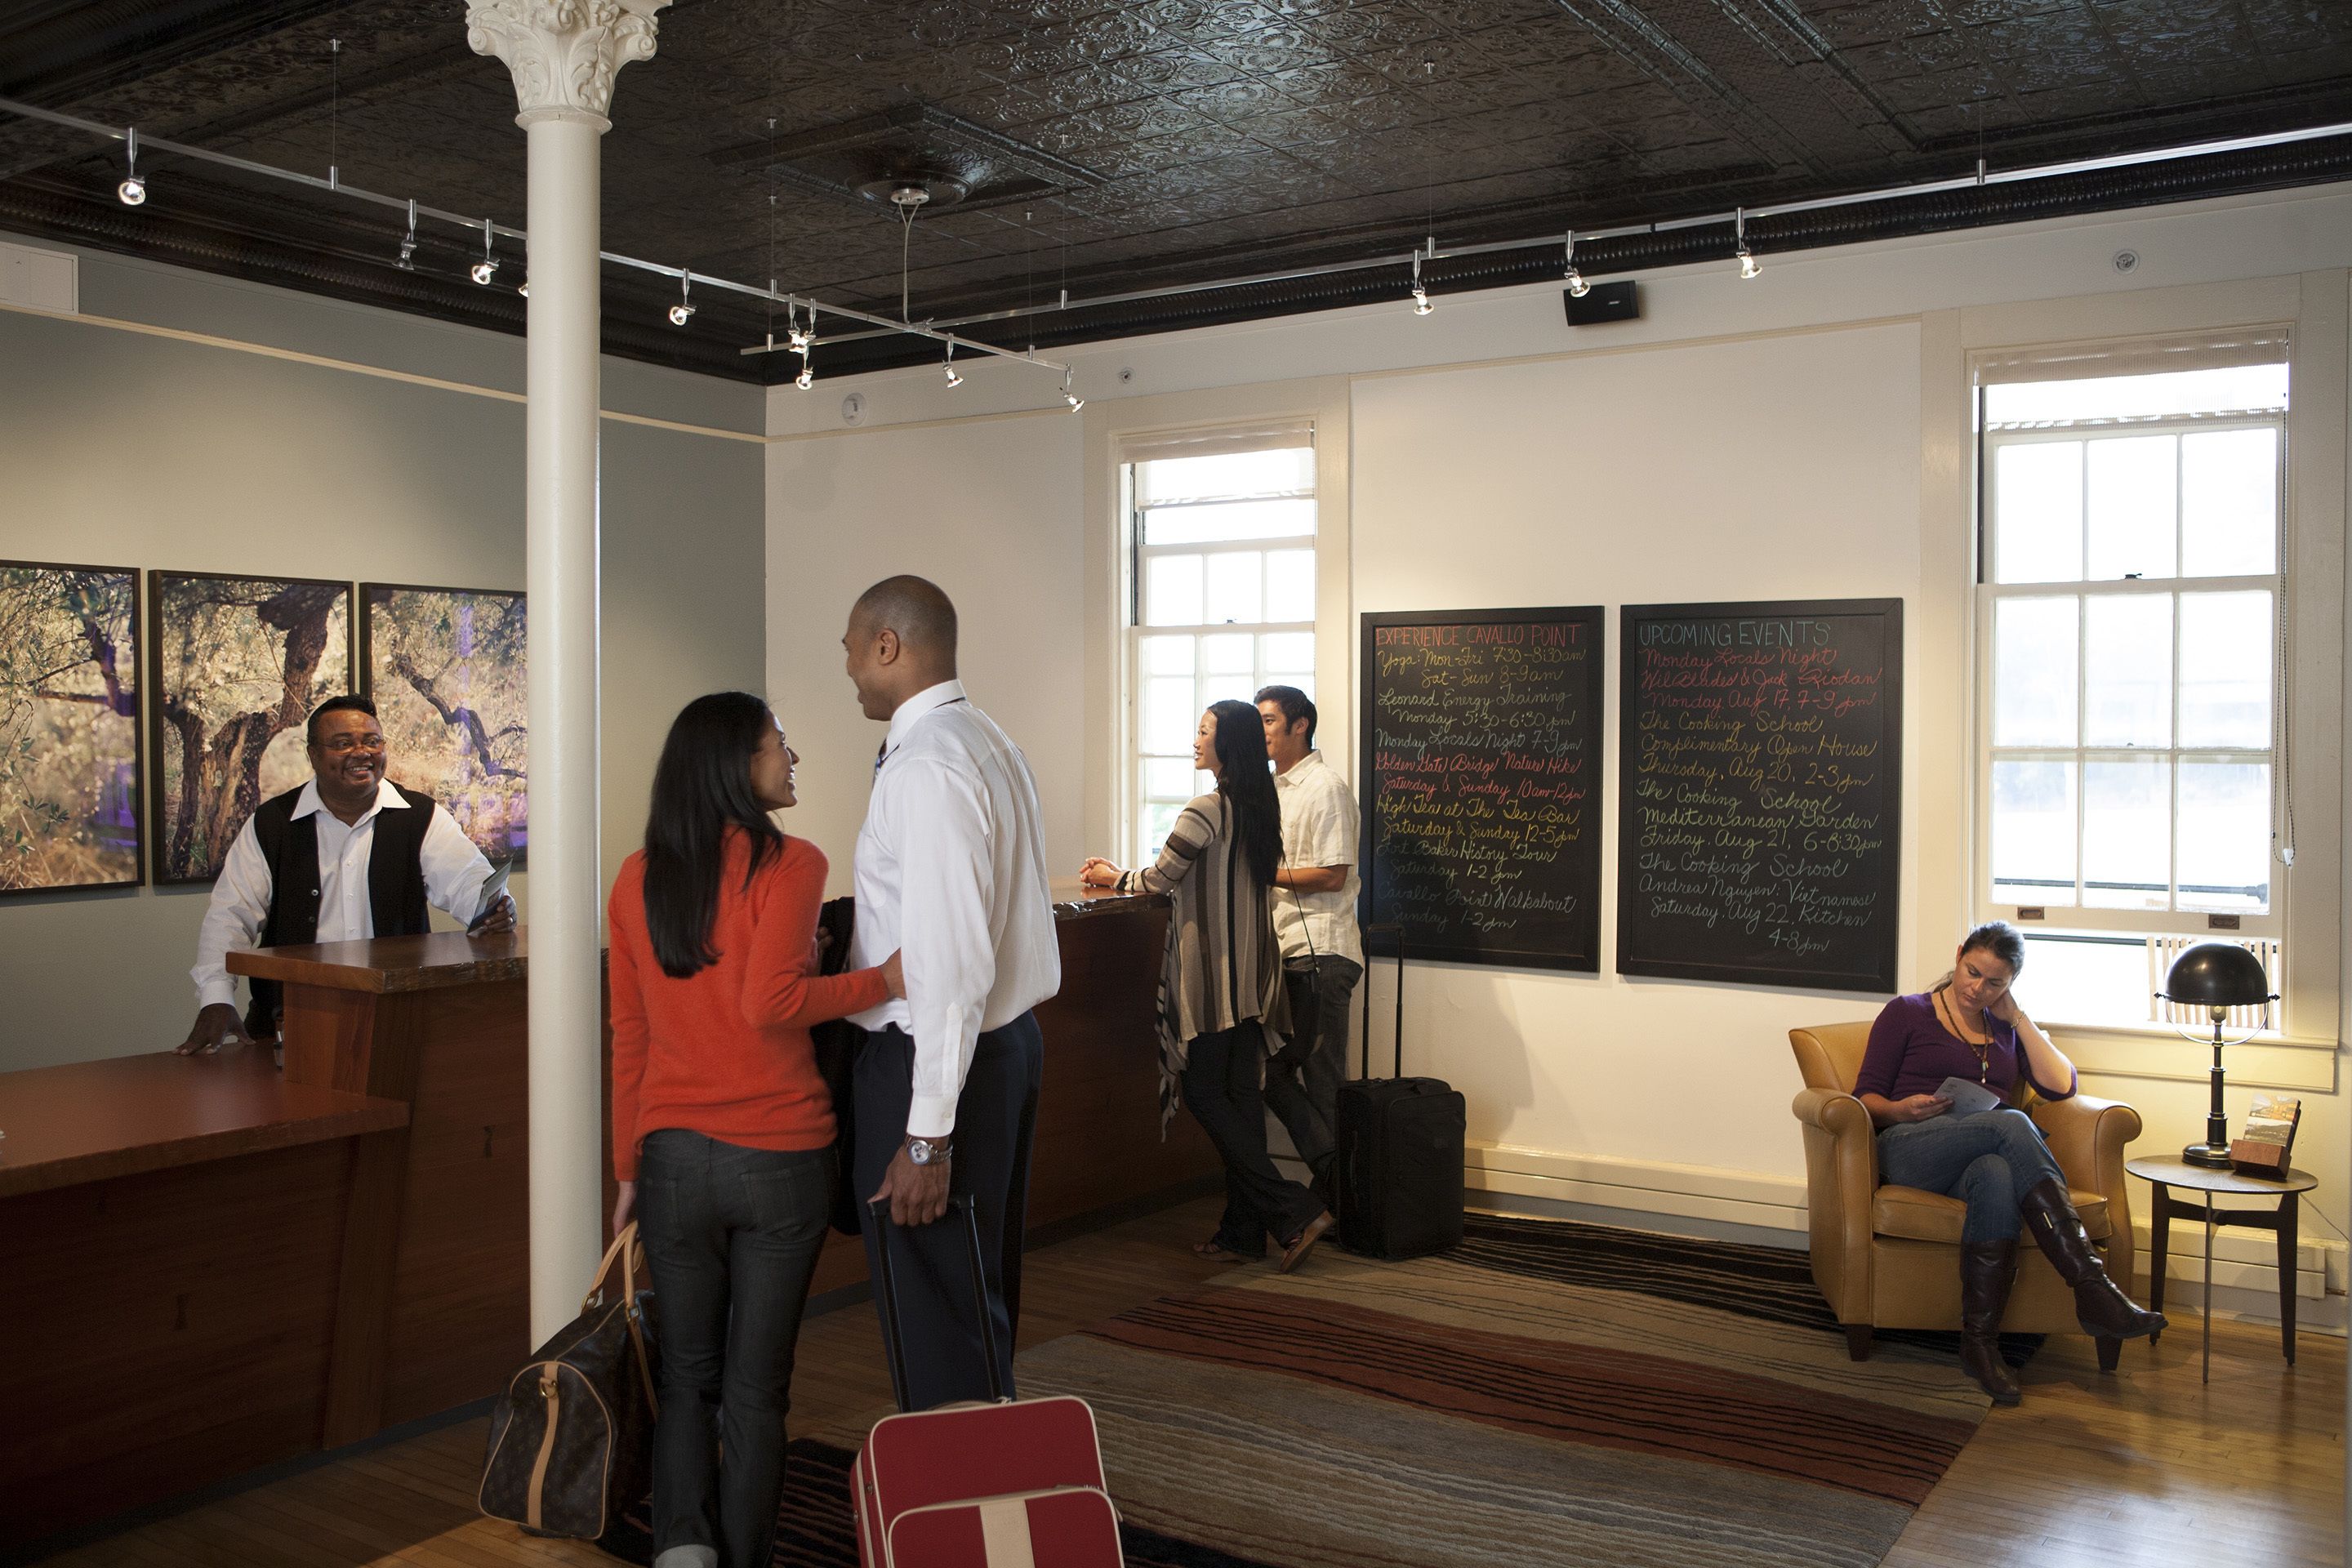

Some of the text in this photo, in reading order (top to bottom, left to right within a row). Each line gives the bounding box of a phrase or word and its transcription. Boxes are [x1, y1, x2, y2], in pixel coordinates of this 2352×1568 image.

[1375, 623, 1582, 648] EXPERIENCE CAVALLO POINT
[1639, 620, 1832, 647] UPCOMING EVENTS
[1638, 646, 1838, 679] Monday Locals Night
[1740, 666, 1751, 687] &
[1378, 683, 1572, 714] Leonard Energy Training
[1728, 689, 1767, 718] Aug
[1392, 709, 1458, 733] Monday
[1639, 710, 1824, 741] The Cooking School
[1375, 728, 1428, 760] Monday
[1428, 726, 1484, 751] Locals
[1484, 728, 1526, 755] Night
[1641, 733, 1878, 764] Complimentary Open House
[1375, 751, 1582, 780] Golden Gate Bridge Nature Hike
[1729, 756, 1764, 791] Aug
[1382, 773, 1437, 800] Saturday
[1442, 774, 1451, 791] &
[1458, 774, 1510, 805] Sunday
[1636, 777, 1842, 817] The Cooking School
[1375, 794, 1581, 825] High Tea at The Tea Bar
[1637, 805, 1878, 831] Mediterranean Garden
[1381, 817, 1454, 847] Saturday
[1455, 820, 1466, 837] &
[1468, 822, 1521, 850] Sunday
[1714, 828, 1764, 860] Aug
[1412, 840, 1459, 858] Baker
[1459, 844, 1508, 872] History
[1512, 843, 1558, 863] Tour
[1639, 851, 1850, 885] The Cooking School
[1389, 858, 1459, 889] Saturday
[1379, 882, 1577, 914] Cavallo Point Walkabout
[1638, 873, 1709, 894] Andrea
[1782, 878, 1877, 906] Vietnamese
[1390, 902, 1449, 933] Sunday
[1727, 900, 1762, 935] Aug
[1797, 904, 1873, 929] Kitchen
